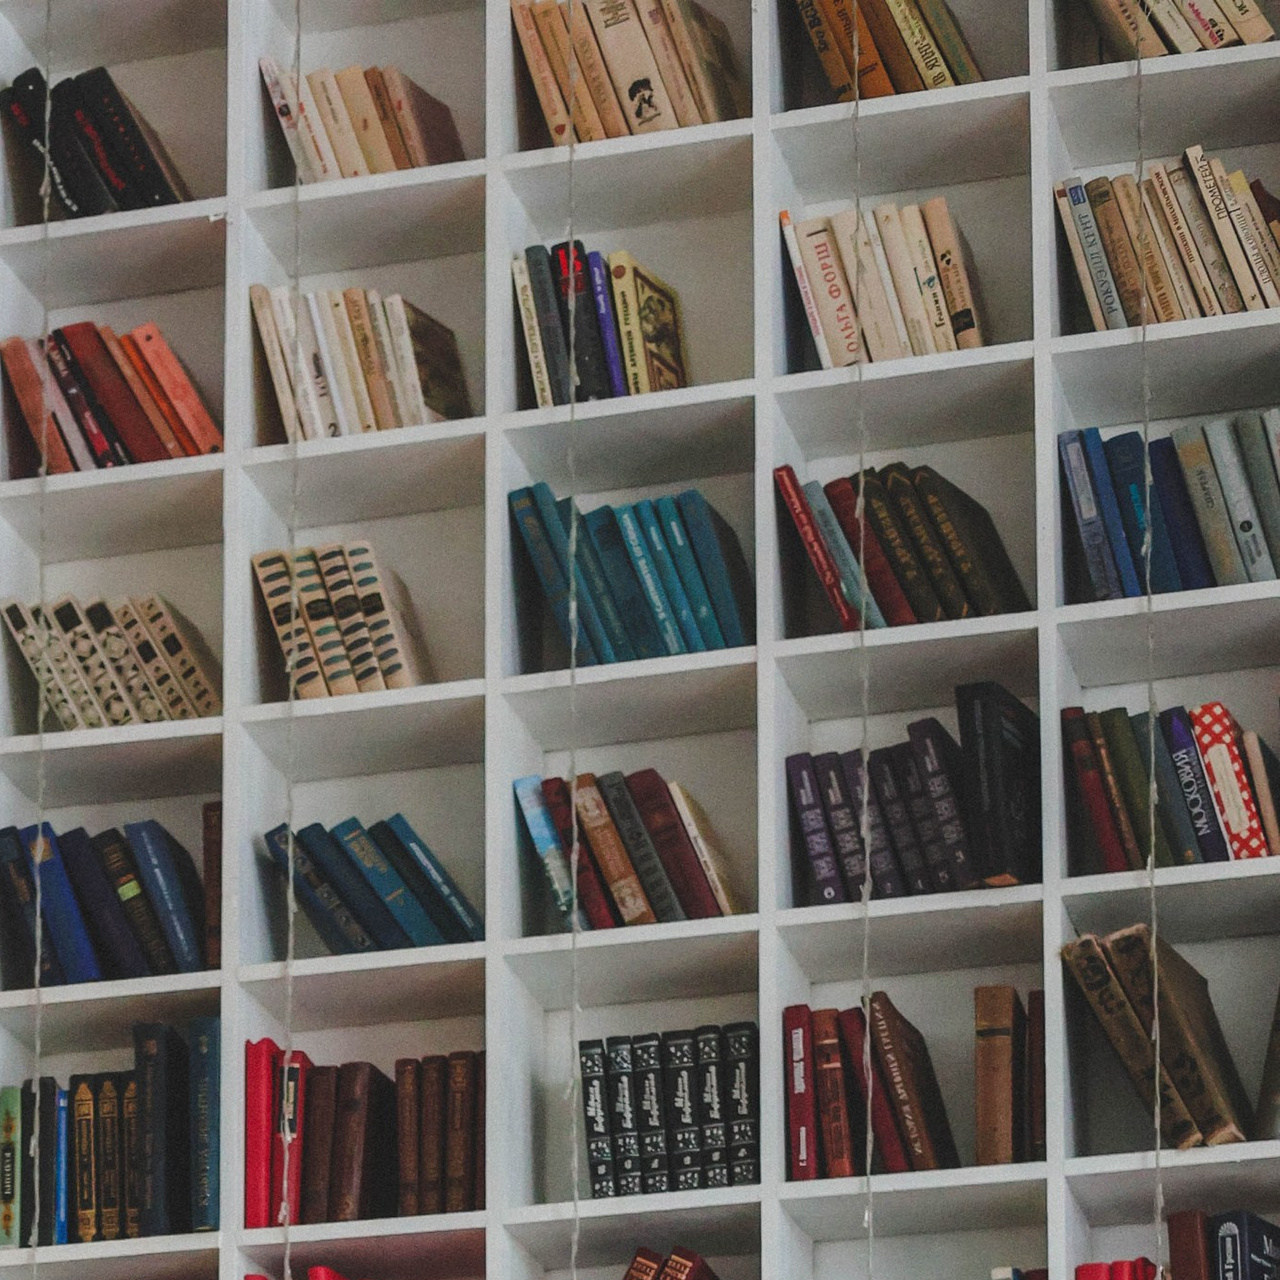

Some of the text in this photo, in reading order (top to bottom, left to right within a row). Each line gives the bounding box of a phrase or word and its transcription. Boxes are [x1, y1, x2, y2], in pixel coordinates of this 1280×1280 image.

[1195, 162, 1228, 220] ПРОМЕТЕЙ
[812, 240, 861, 354] ОЛЬГА ФОРШ
[1077, 211, 1119, 315] РОКУЭЛЛ КЕНТ
[1172, 748, 1212, 835] МОСКОВИЯ
[871, 1001, 923, 1155] ИСТОРИЯ ДРЕВНЕЙ ГРЕЦИИ
